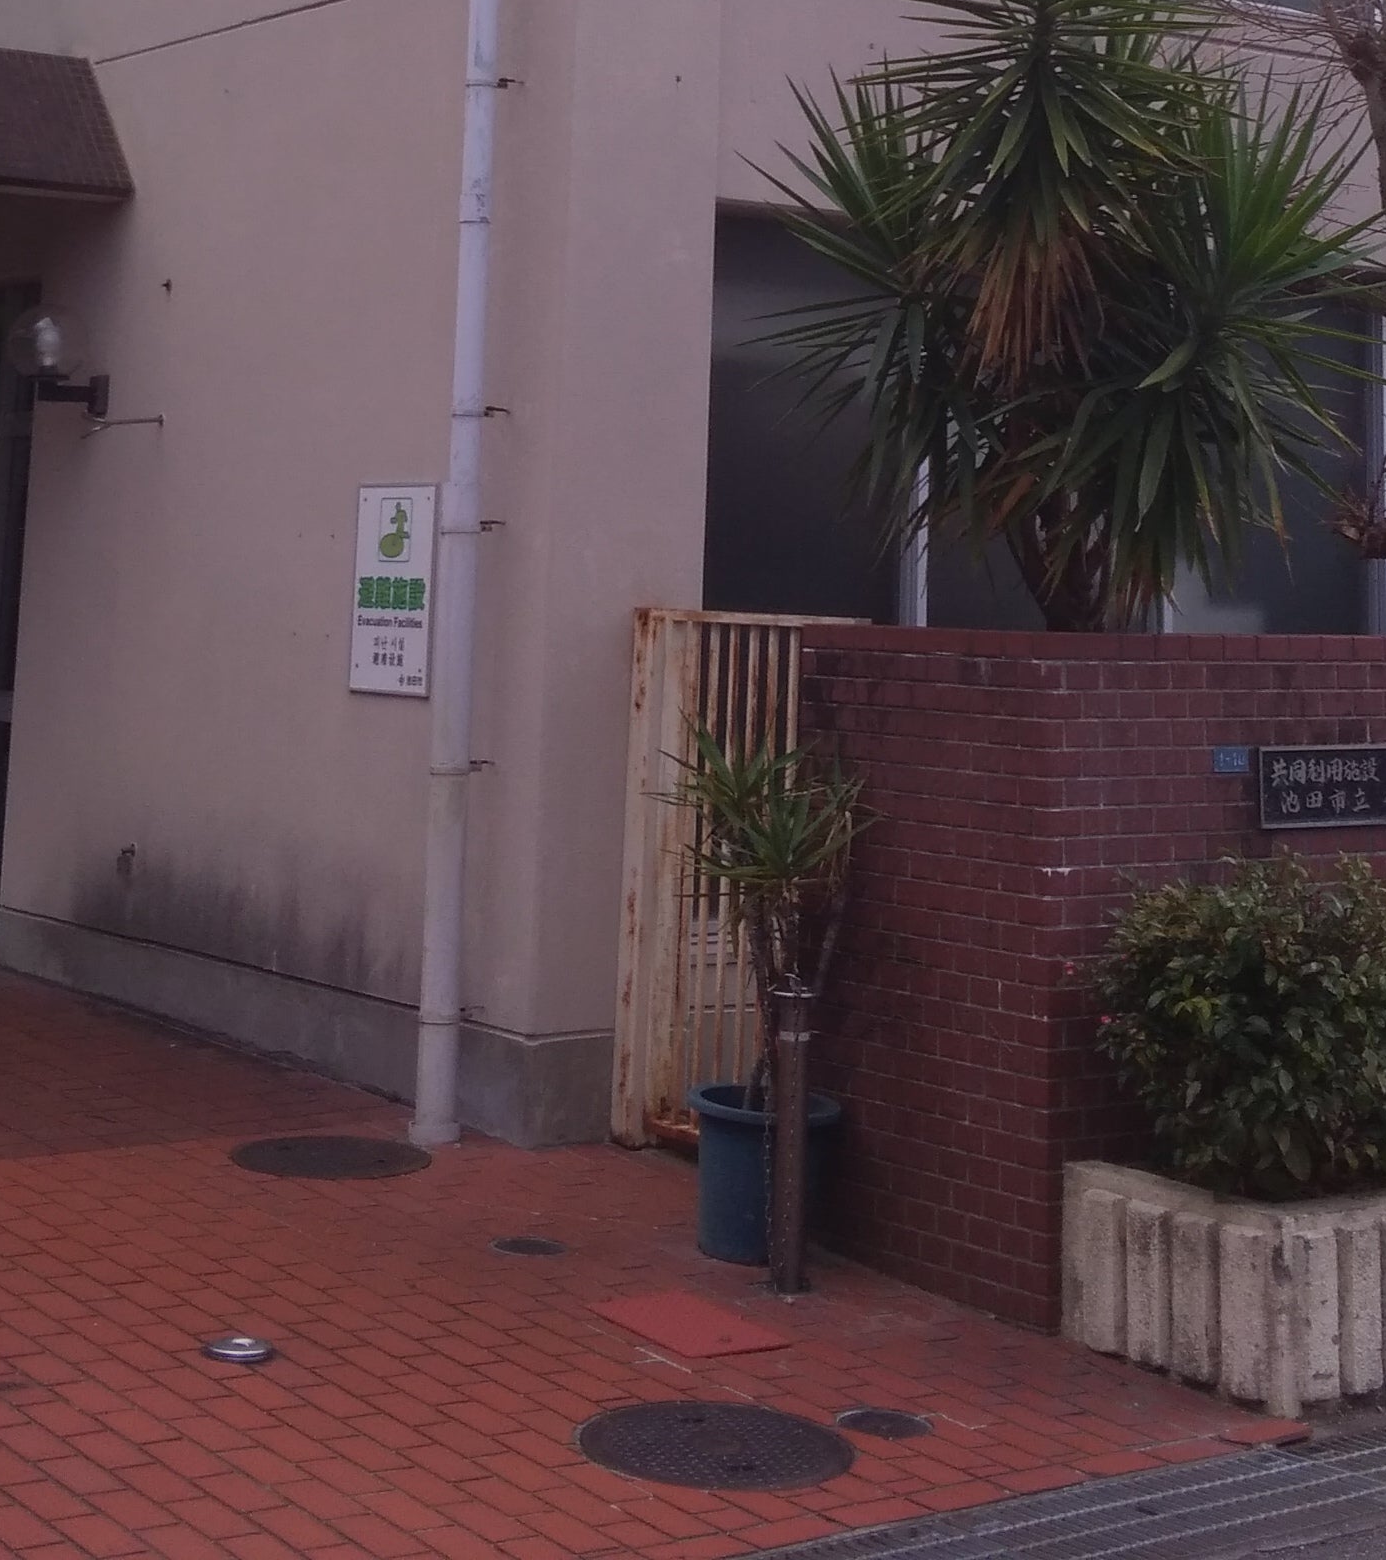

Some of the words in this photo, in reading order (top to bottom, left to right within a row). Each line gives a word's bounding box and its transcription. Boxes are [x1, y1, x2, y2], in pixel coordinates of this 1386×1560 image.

[357, 575, 426, 611] 避難施設
[358, 614, 392, 627] Evacuation
[393, 616, 423, 629] Facilities
[1269, 757, 1381, 788] 共同利用施設
[1280, 789, 1372, 815] 池田市立
